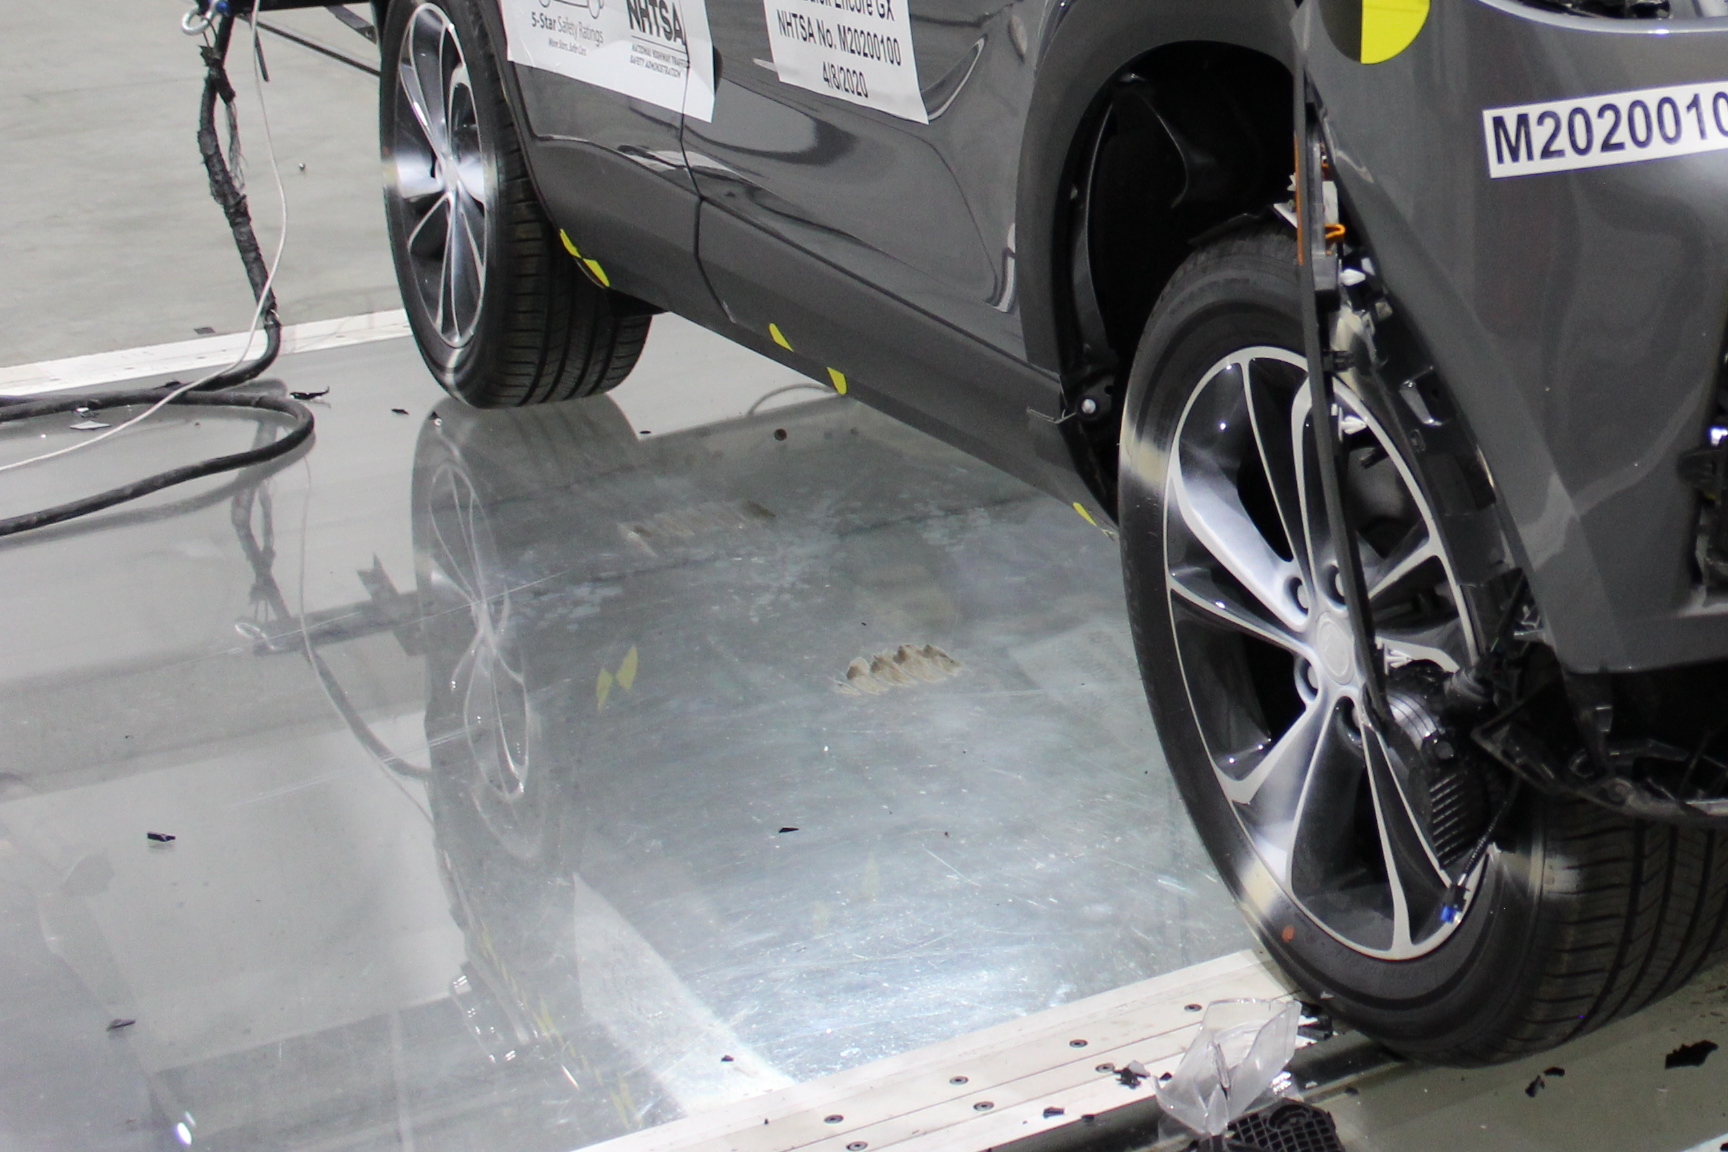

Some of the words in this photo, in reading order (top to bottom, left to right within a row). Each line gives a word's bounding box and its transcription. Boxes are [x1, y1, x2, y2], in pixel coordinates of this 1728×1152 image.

[531, 11, 556, 31] 5-Star
[558, 16, 577, 40] Safety
[578, 21, 604, 47] Ratings
[777, 9, 816, 47] NHTSA
[817, 19, 837, 50] No.
[837, 24, 902, 66] M20200100
[823, 61, 868, 98] 4/8/2020
